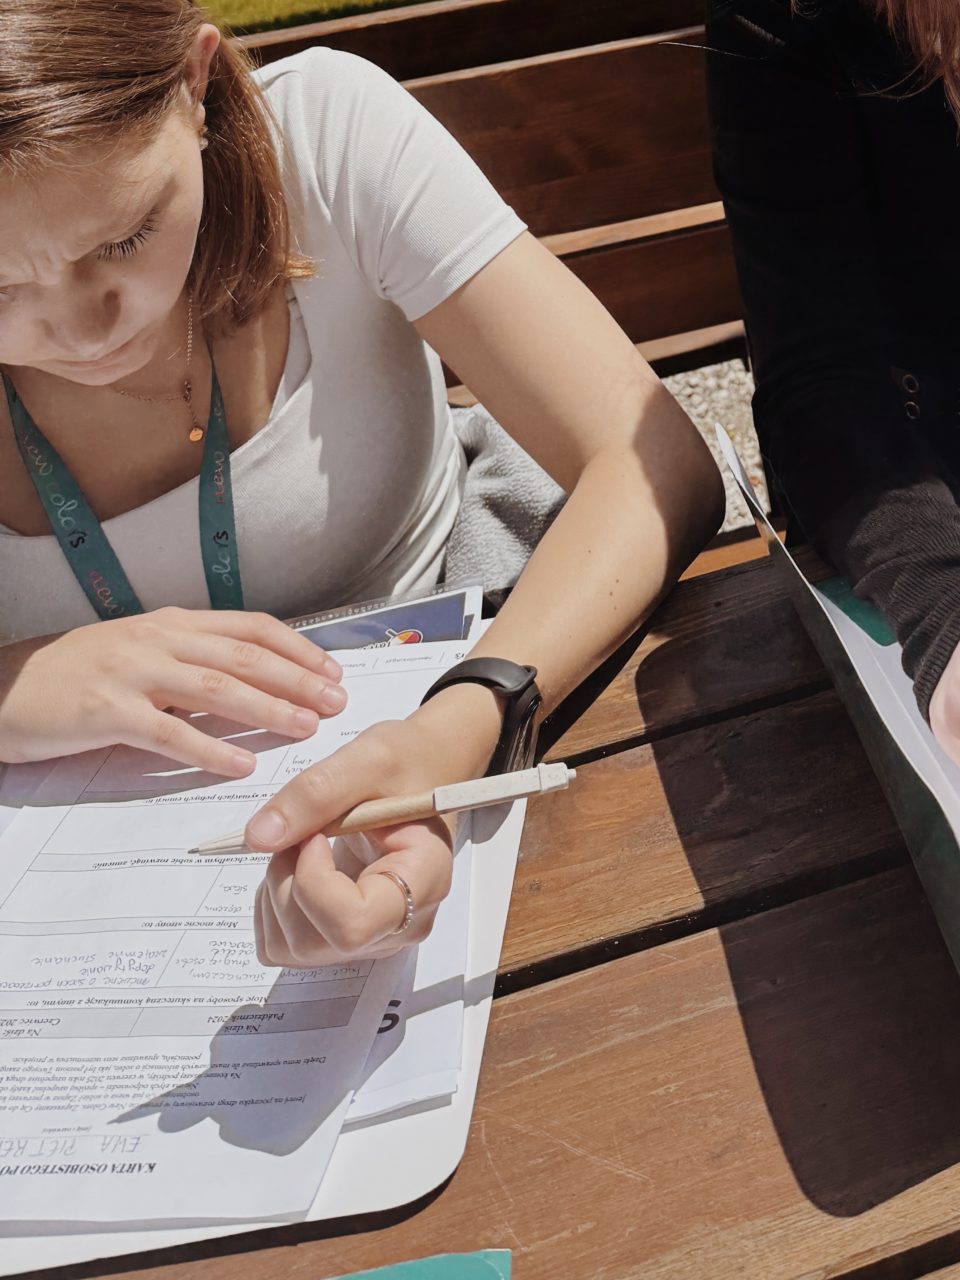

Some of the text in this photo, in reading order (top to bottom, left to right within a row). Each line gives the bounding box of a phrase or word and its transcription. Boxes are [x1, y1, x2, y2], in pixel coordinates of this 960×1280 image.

[207, 1015, 228, 1023] 2024
[0, 1135, 140, 1158] EWA PIETRE
[23, 1163, 108, 1175] OSOBISTEGO
[111, 1162, 157, 1174] KARTA
